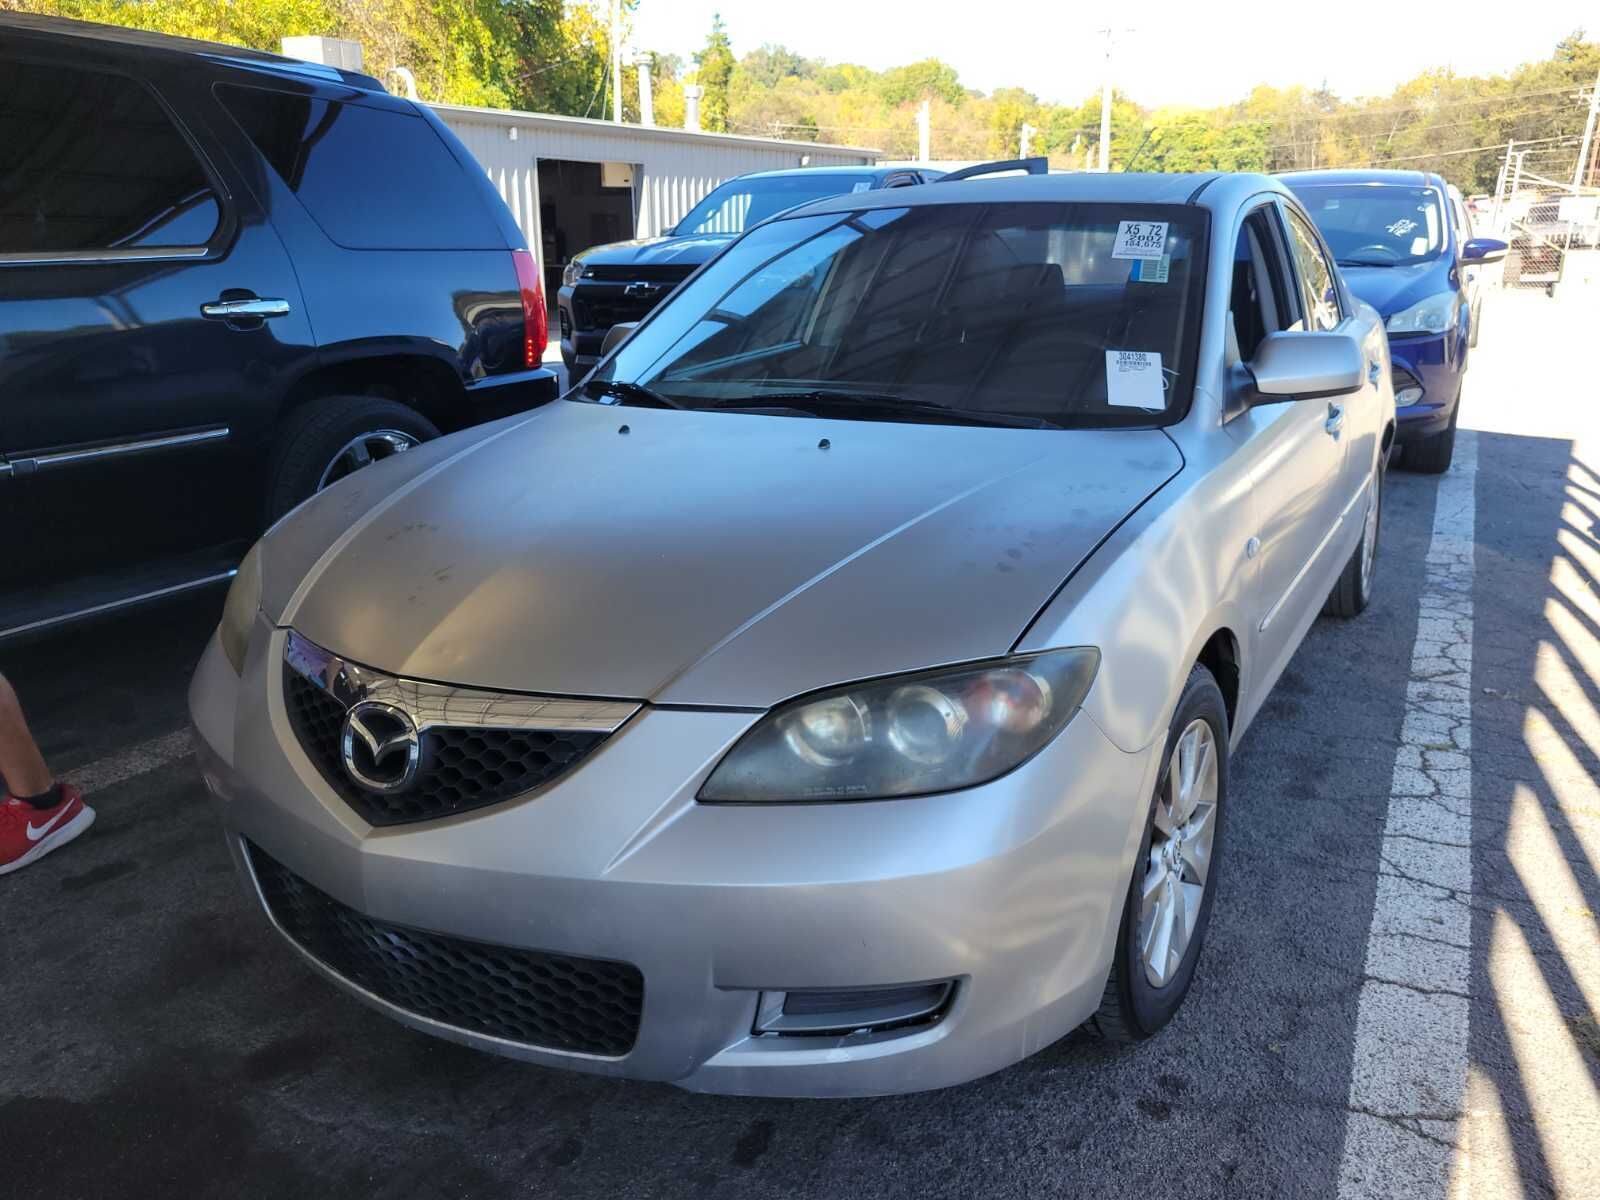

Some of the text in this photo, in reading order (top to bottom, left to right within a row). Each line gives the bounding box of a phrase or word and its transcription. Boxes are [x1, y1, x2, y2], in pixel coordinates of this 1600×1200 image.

[1125, 224, 1162, 236] X5 72
[1129, 234, 1163, 242] 2007
